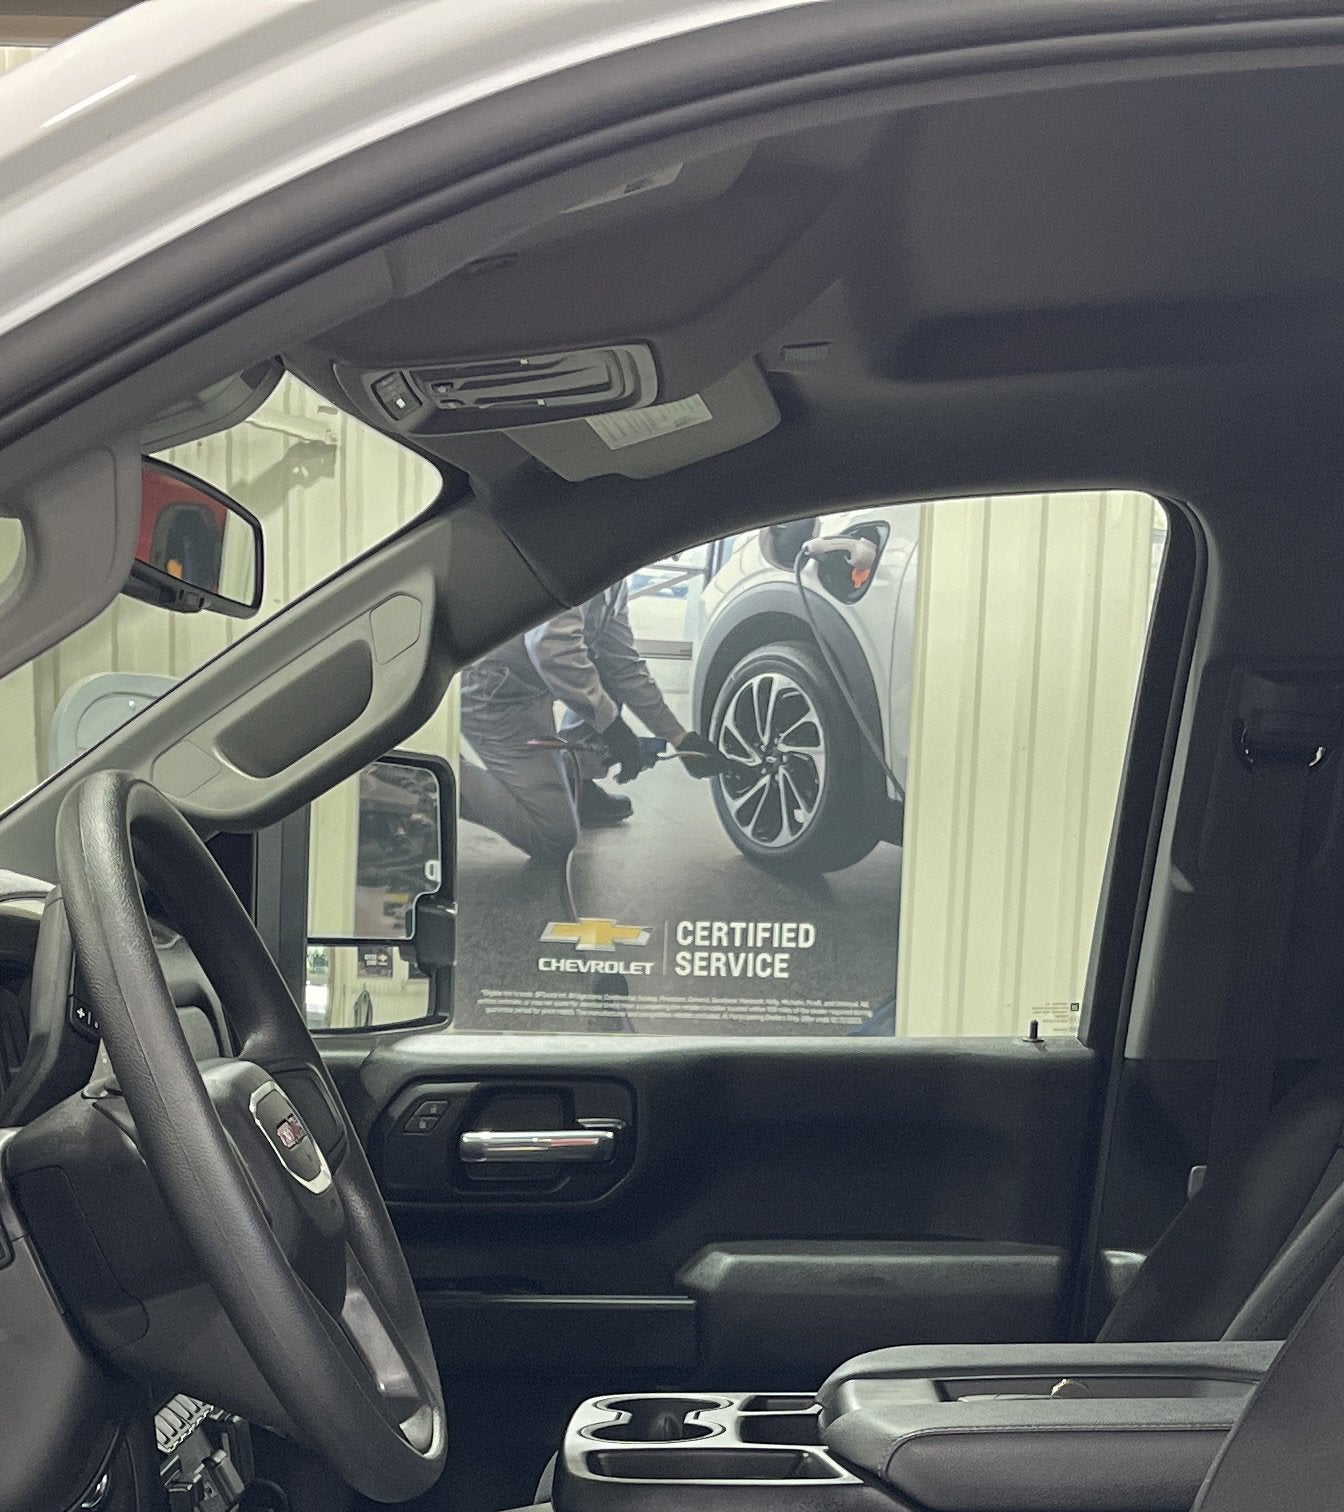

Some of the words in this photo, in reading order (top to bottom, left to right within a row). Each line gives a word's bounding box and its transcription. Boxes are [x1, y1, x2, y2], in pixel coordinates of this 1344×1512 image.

[675, 920, 816, 948] CERTIFIED
[538, 957, 655, 975] CHEVROLET
[674, 951, 790, 978] SERVICE
